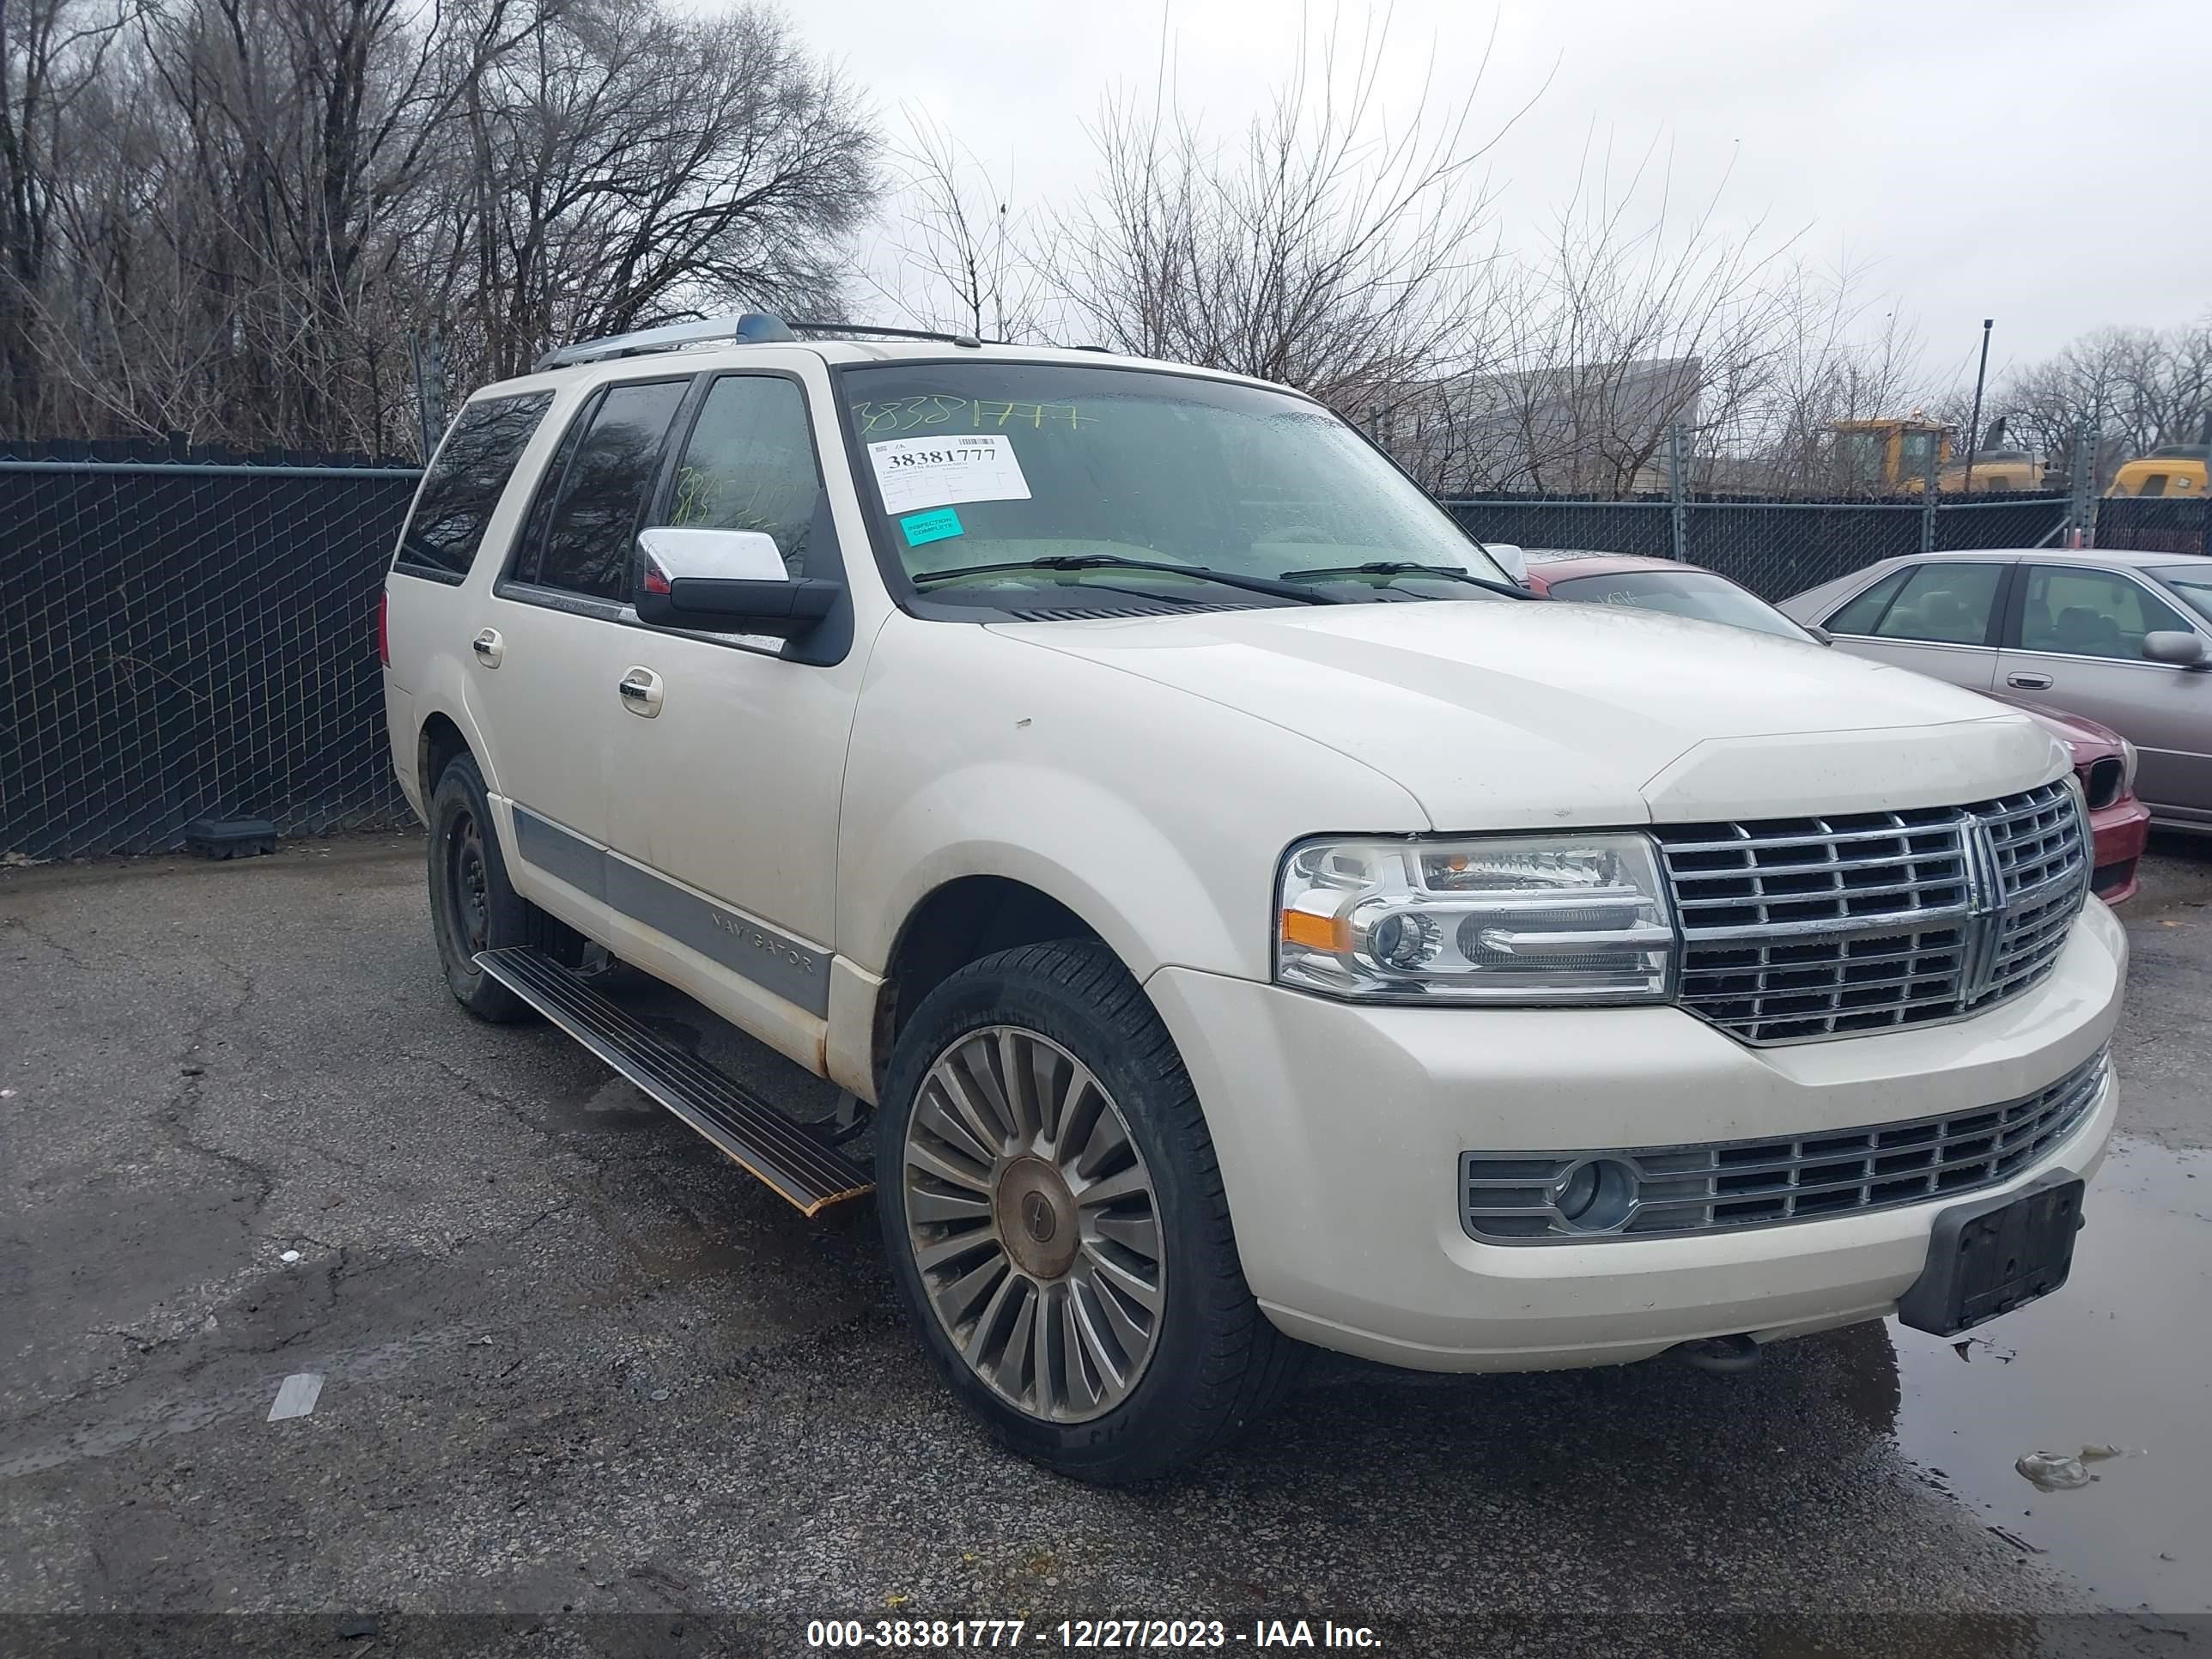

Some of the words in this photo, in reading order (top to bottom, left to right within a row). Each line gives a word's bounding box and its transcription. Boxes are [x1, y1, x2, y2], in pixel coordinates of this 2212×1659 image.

[852, 394, 1100, 434] 38381777
[887, 448, 996, 470] 38381777
[907, 517, 953, 531] INSPECTION
[913, 523, 953, 536] COMPLETE
[711, 913, 814, 974] NAVIGATOR
